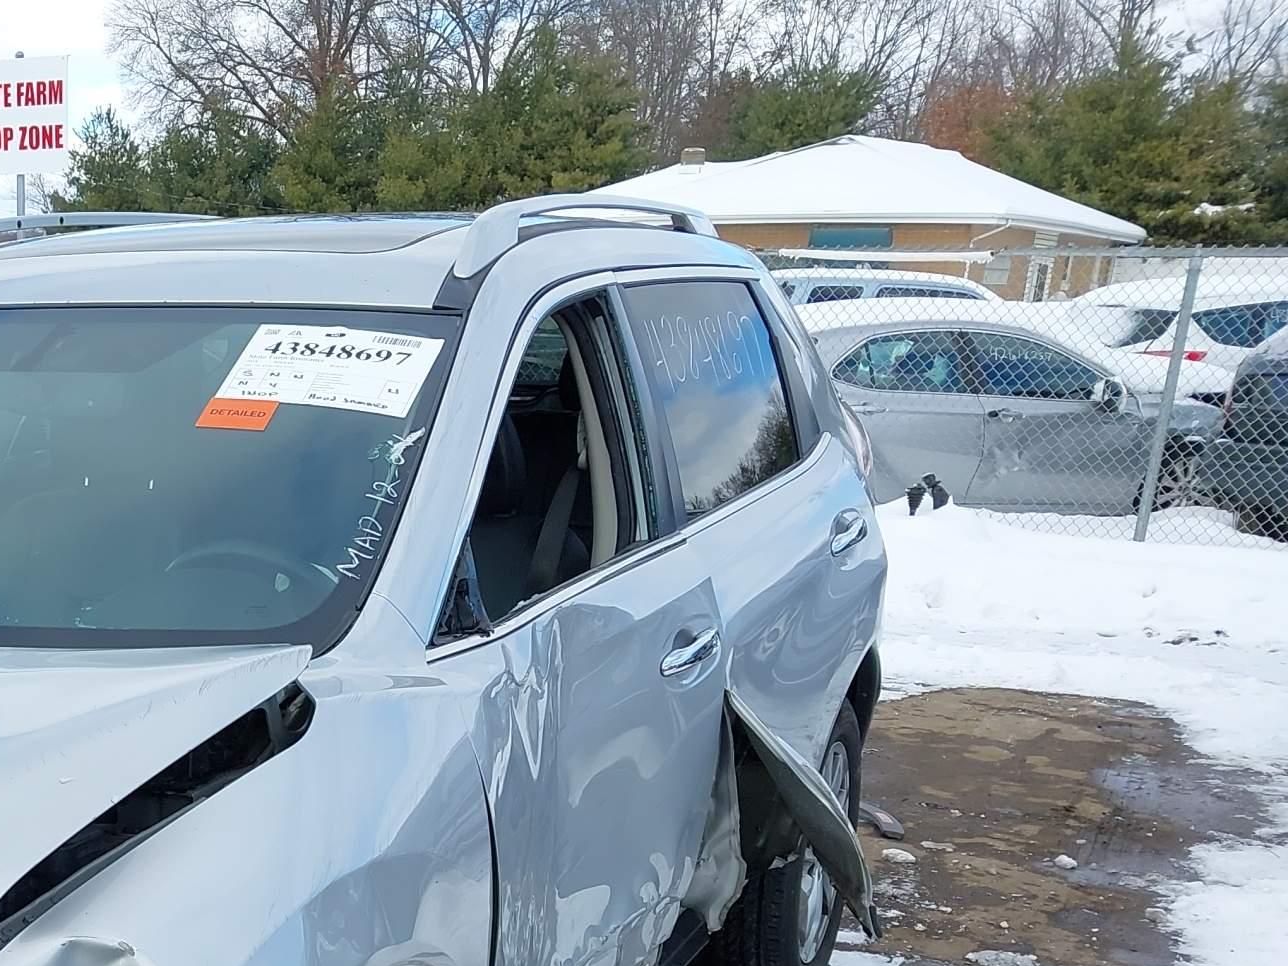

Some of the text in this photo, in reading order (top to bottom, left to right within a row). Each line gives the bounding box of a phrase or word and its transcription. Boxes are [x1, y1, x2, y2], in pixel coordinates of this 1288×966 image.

[17, 80, 63, 106] FARM
[19, 125, 64, 150] ZONE
[264, 340, 413, 366] 43848697
[643, 310, 767, 393] 43848697
[209, 407, 266, 418] DETAILED
[336, 515, 383, 580] MAD
